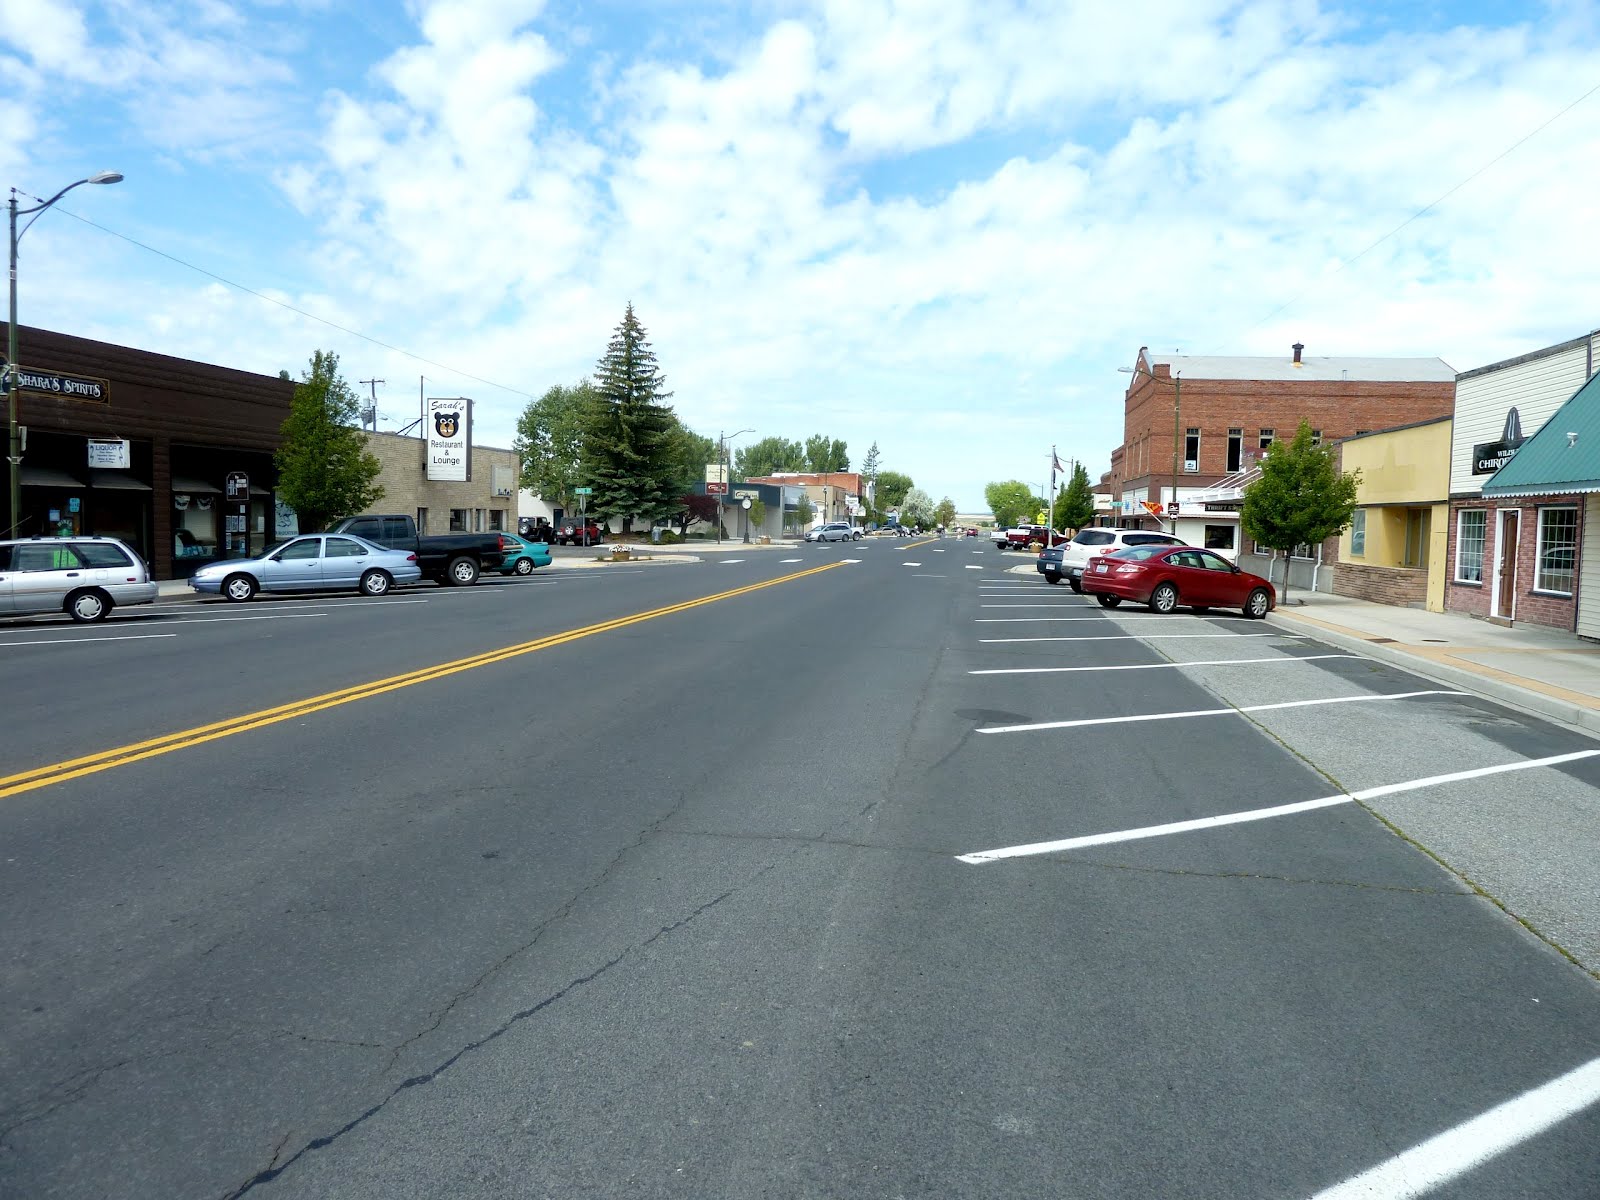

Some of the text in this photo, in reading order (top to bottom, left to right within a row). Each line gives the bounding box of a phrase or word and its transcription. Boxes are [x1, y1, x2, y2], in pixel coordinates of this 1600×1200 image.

[17, 372, 101, 397] SHARA'S SPIRITS
[431, 400, 464, 411] Sarah's
[431, 440, 463, 449] Restaurant
[433, 456, 460, 465] Lounge
